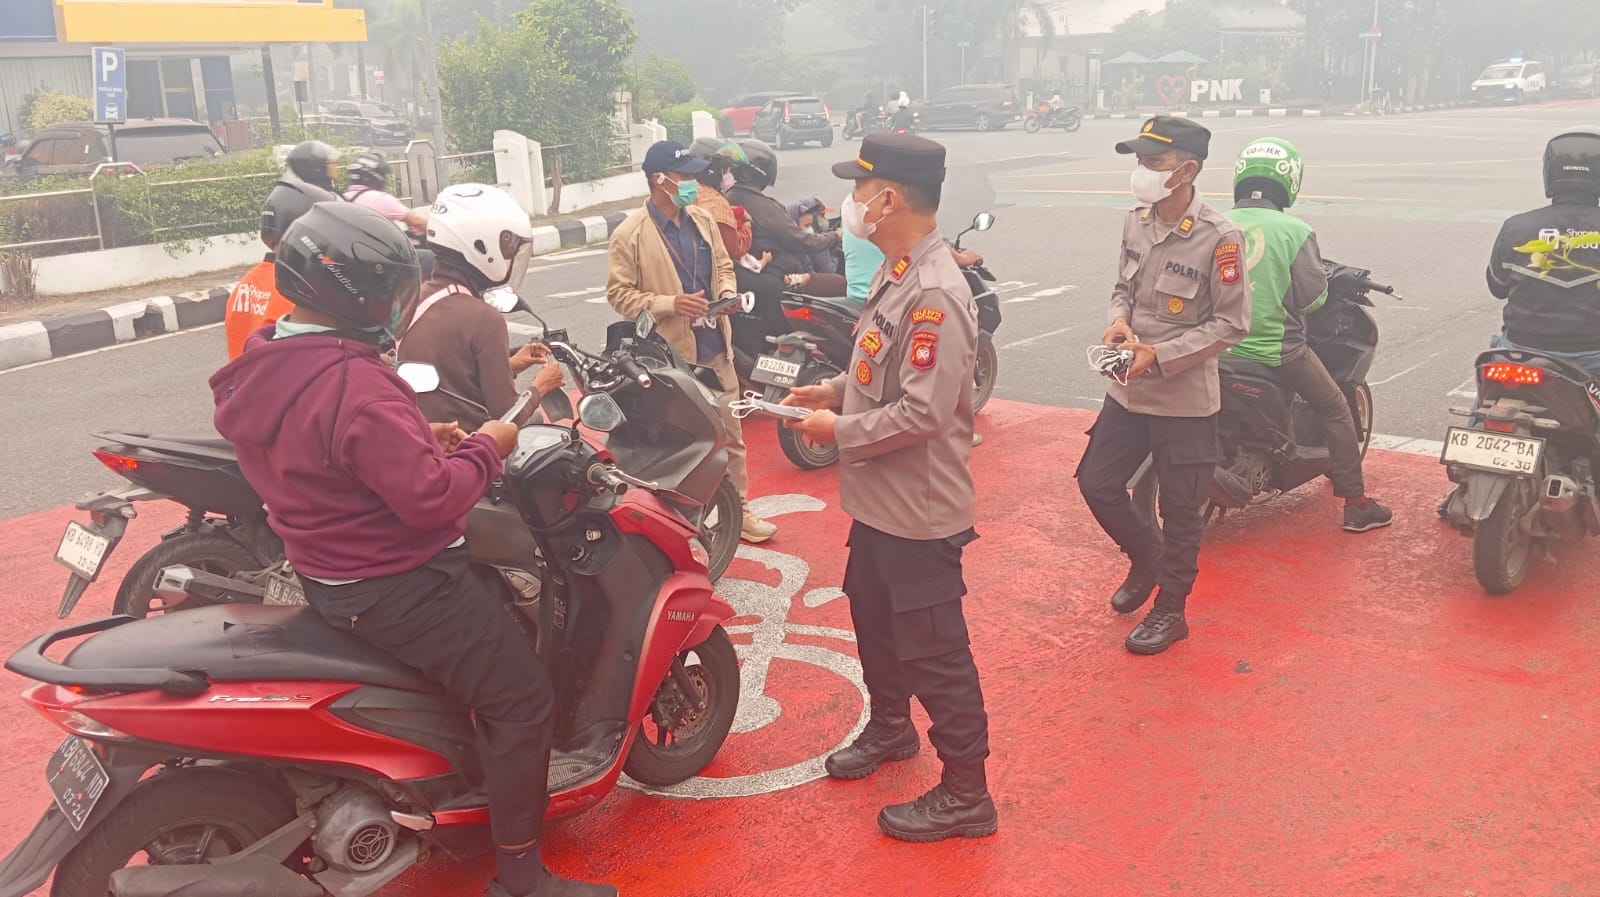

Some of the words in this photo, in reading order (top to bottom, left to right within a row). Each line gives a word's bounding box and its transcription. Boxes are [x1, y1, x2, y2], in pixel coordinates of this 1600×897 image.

[102, 51, 118, 82] P
[1190, 78, 1244, 103] PNK
[1165, 260, 1199, 279] POLRI
[872, 309, 898, 338] POLRI
[1450, 432, 1469, 447] KB
[1475, 436, 1511, 453] 2042
[1516, 442, 1534, 457] BA
[1493, 457, 1531, 471] 02-30
[269, 576, 281, 599] KB
[667, 609, 695, 622] YAMAHA
[85, 772, 104, 800] ND
